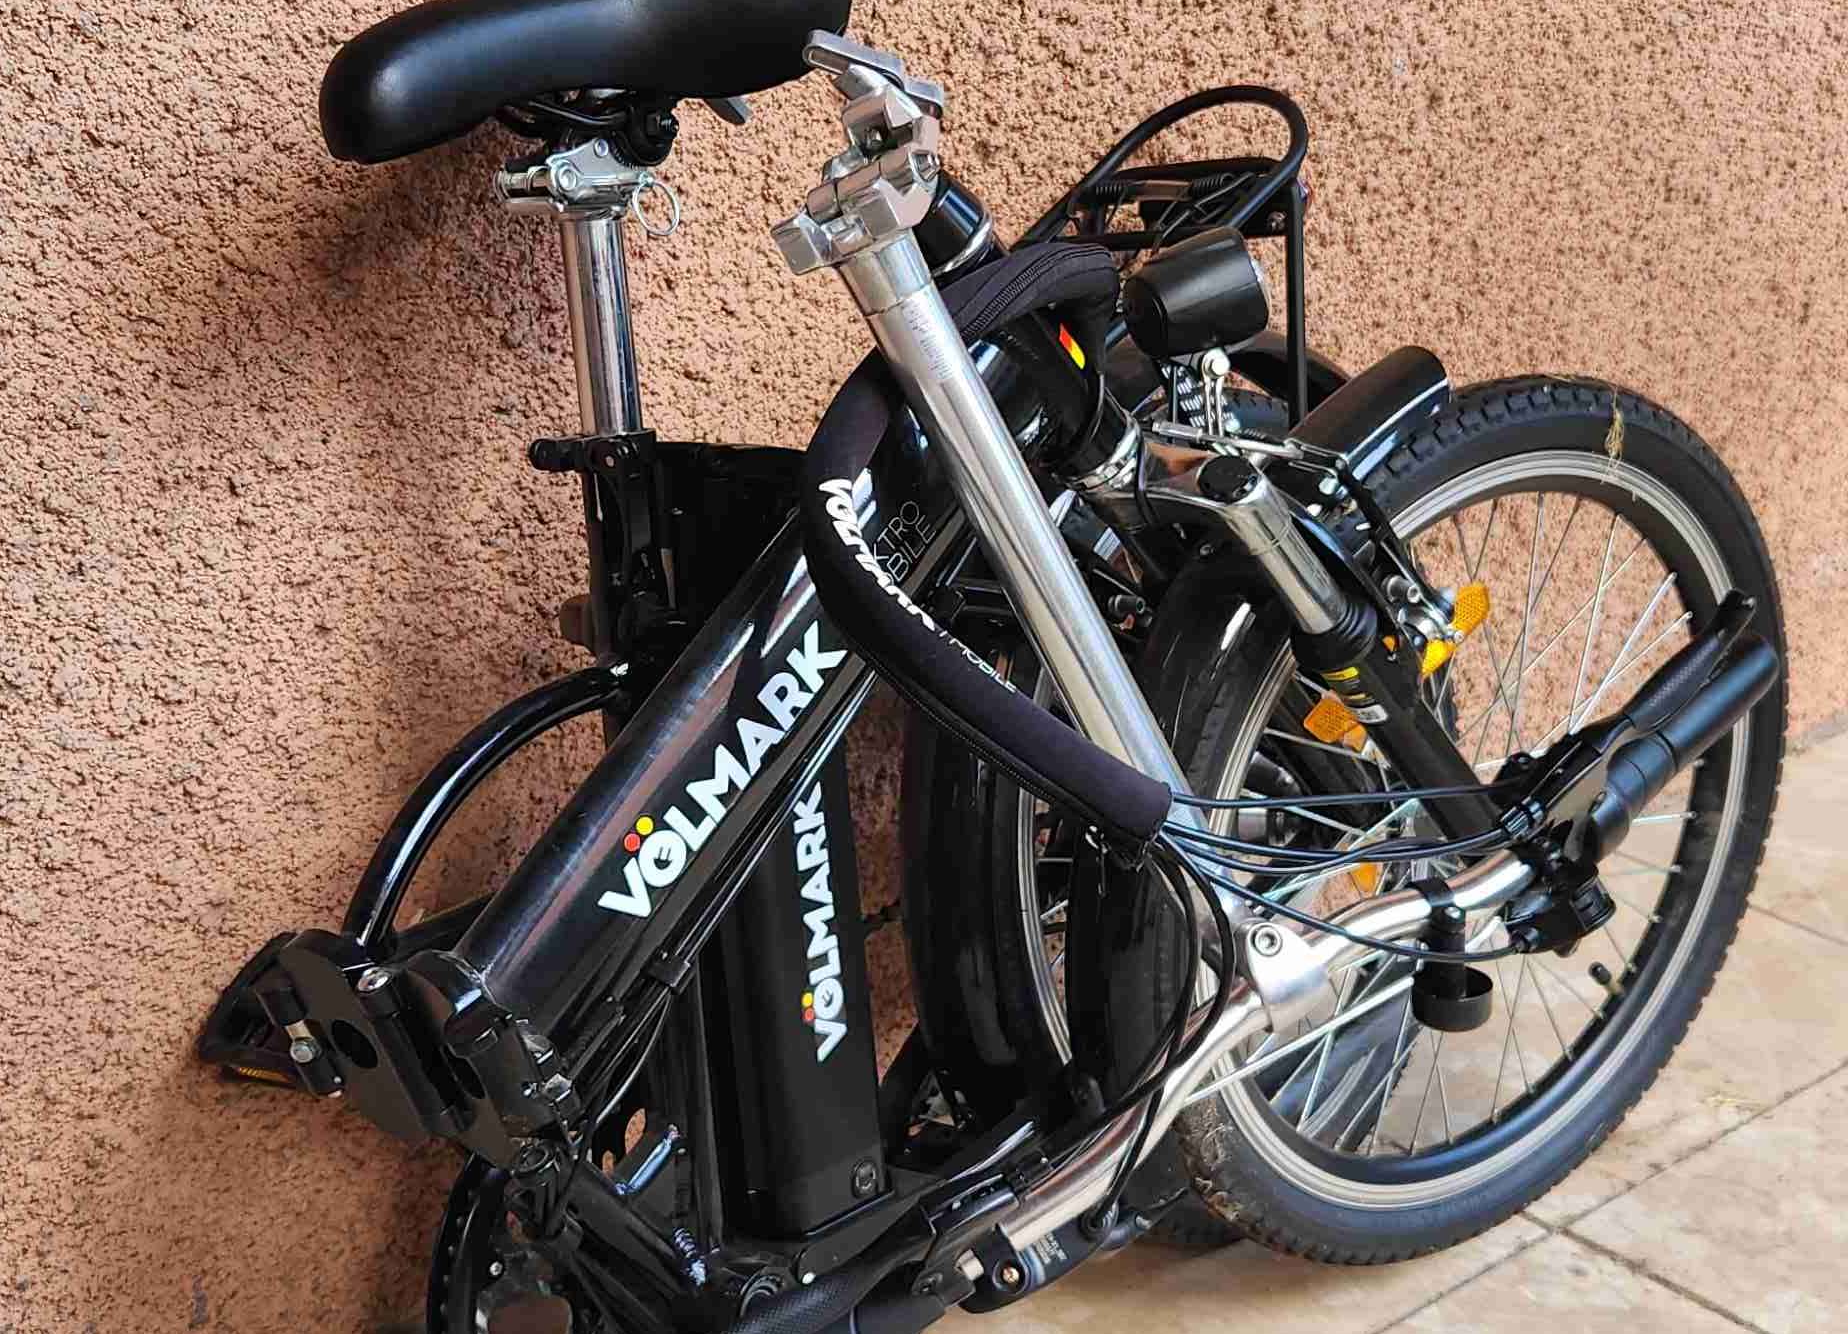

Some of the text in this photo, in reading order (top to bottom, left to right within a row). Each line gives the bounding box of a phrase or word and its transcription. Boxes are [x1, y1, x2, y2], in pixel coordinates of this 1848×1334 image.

[873, 500, 919, 561] KTRO
[886, 514, 937, 582] BILE
[598, 619, 848, 918] VÖLMARK
